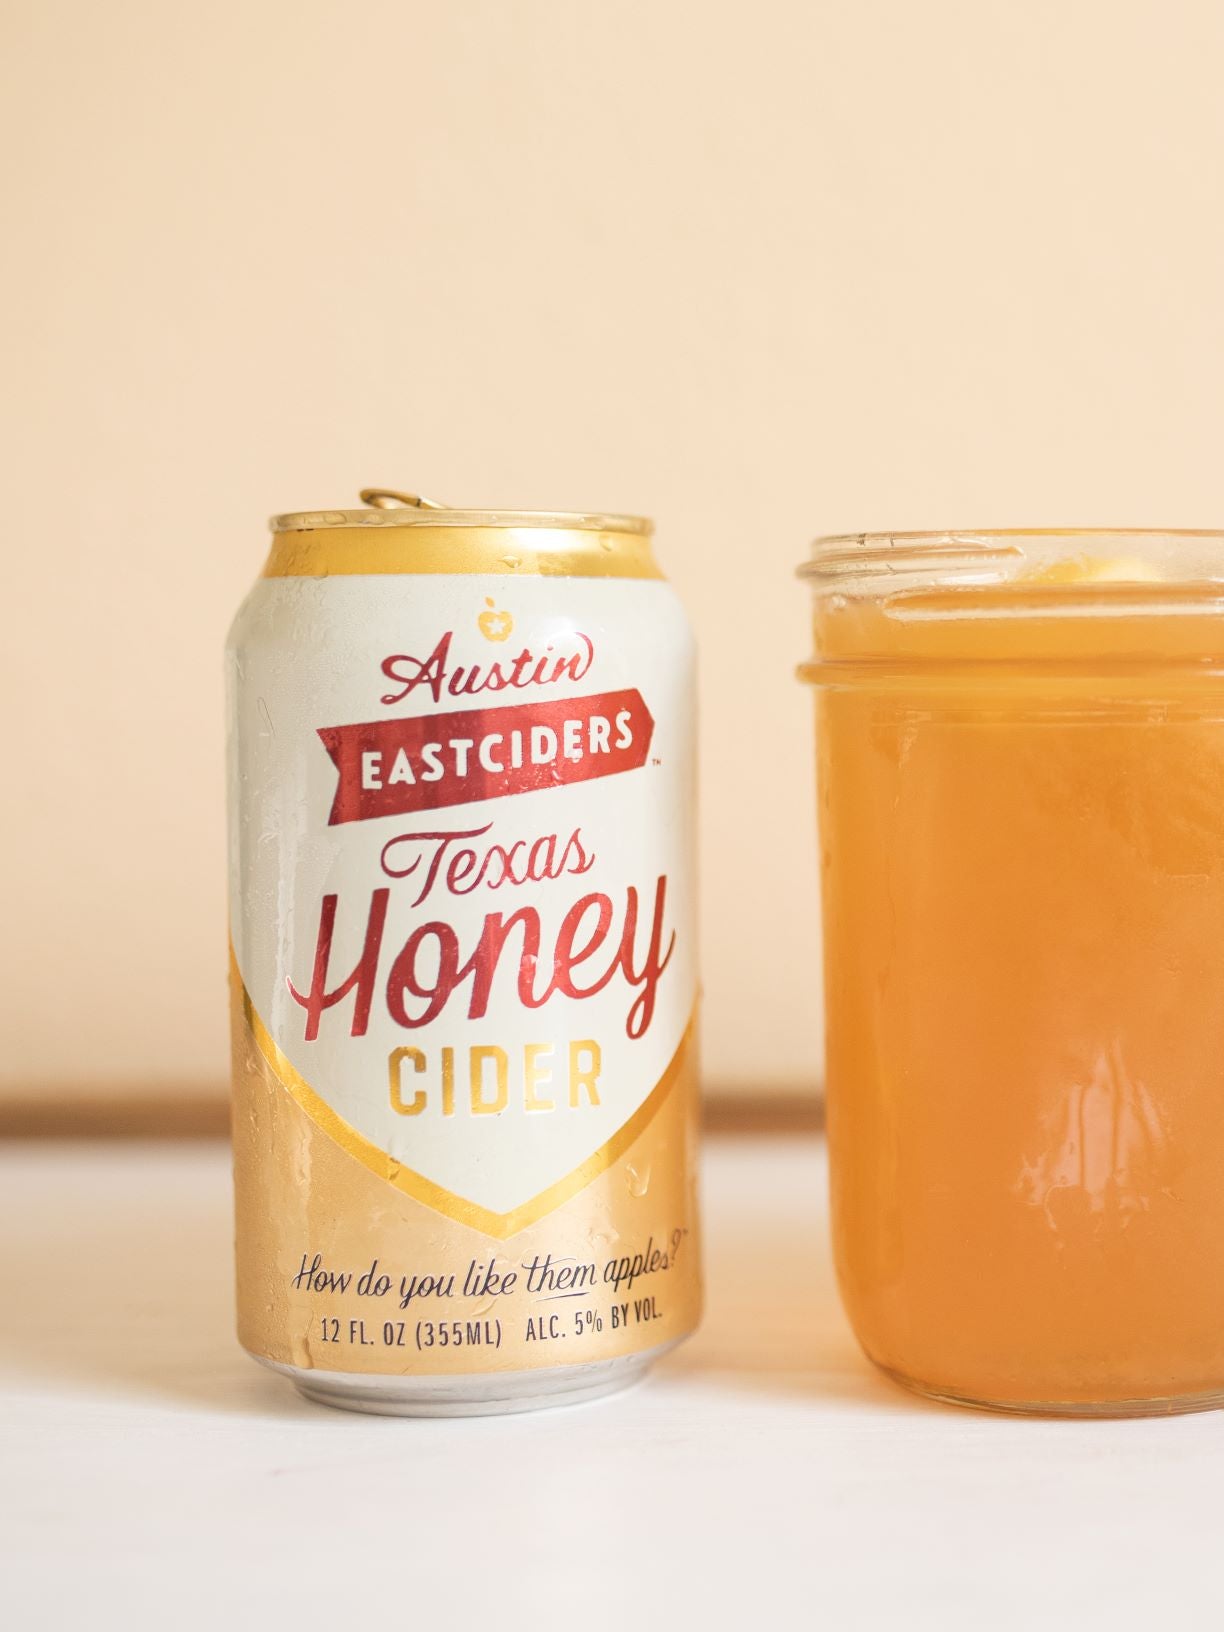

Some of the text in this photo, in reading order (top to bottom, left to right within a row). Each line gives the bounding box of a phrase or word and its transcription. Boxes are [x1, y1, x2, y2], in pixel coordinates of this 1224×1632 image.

[381, 631, 594, 704] Austin
[362, 707, 633, 790] EASTCIDERS
[380, 822, 596, 908] Texas
[285, 874, 677, 1042] Honey
[388, 1039, 601, 1118] CIDER
[291, 1228, 682, 1310] How do you like them apples?
[321, 1317, 502, 1351] 12 FL. OZ (355ML)
[525, 1296, 663, 1342] ALC. 5% BY VOL.
